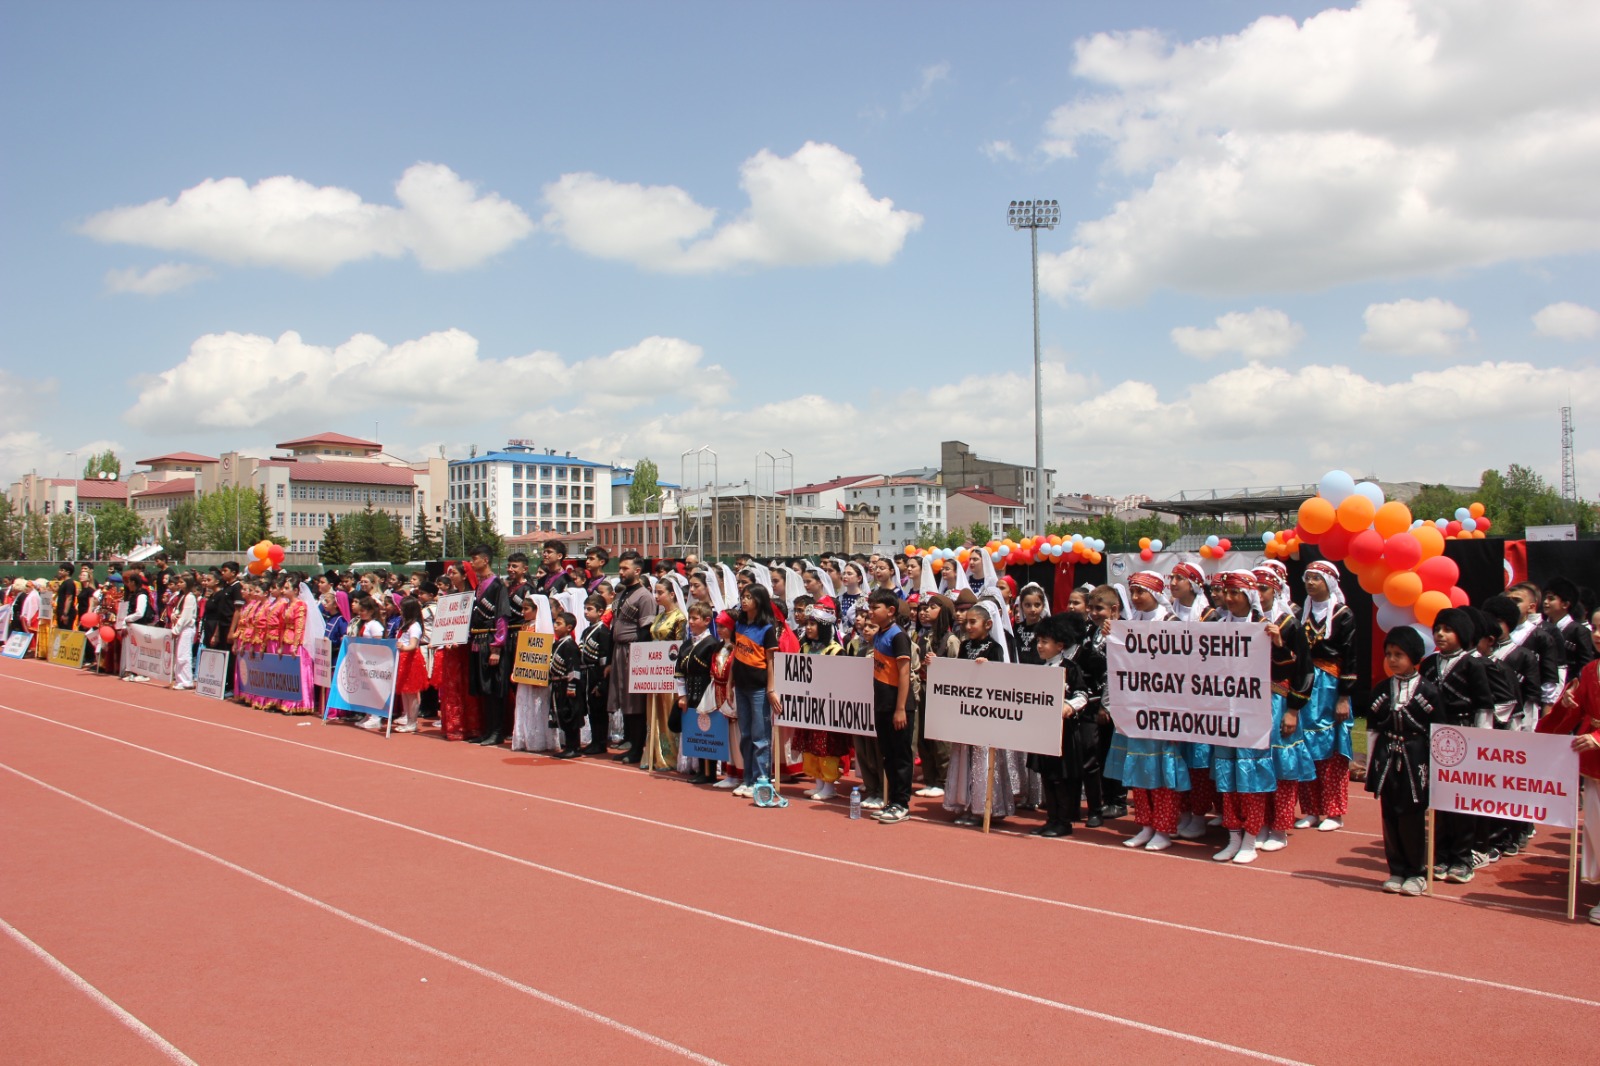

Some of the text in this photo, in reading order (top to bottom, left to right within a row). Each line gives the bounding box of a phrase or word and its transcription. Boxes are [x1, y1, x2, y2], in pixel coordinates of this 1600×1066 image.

[449, 602, 459, 612] KARS
[528, 636, 544, 648] KARS
[1125, 628, 1252, 662] ÖLÇÜLÜ ŞEHİT
[648, 651, 663, 660] KARS
[514, 667, 549, 681] ORTAOKULU
[631, 664, 675, 676] HÜSNÜ M.ÖZYEĞİ
[785, 654, 812, 684] KARS
[633, 679, 675, 691] ANADOLU LİSESİ
[933, 683, 1055, 707] MERKEZ YENİŞEHİR
[1116, 671, 1262, 700] TURGAY SALGAR
[778, 690, 875, 732] ATATÜRK İLKOKUL
[960, 701, 1023, 722] İLKOKULU
[1135, 710, 1241, 739] ORTAOKULU
[1476, 746, 1528, 765] KARS
[1437, 768, 1568, 797] NAMIK KEMAL
[1454, 793, 1548, 822] İLKOKULU
